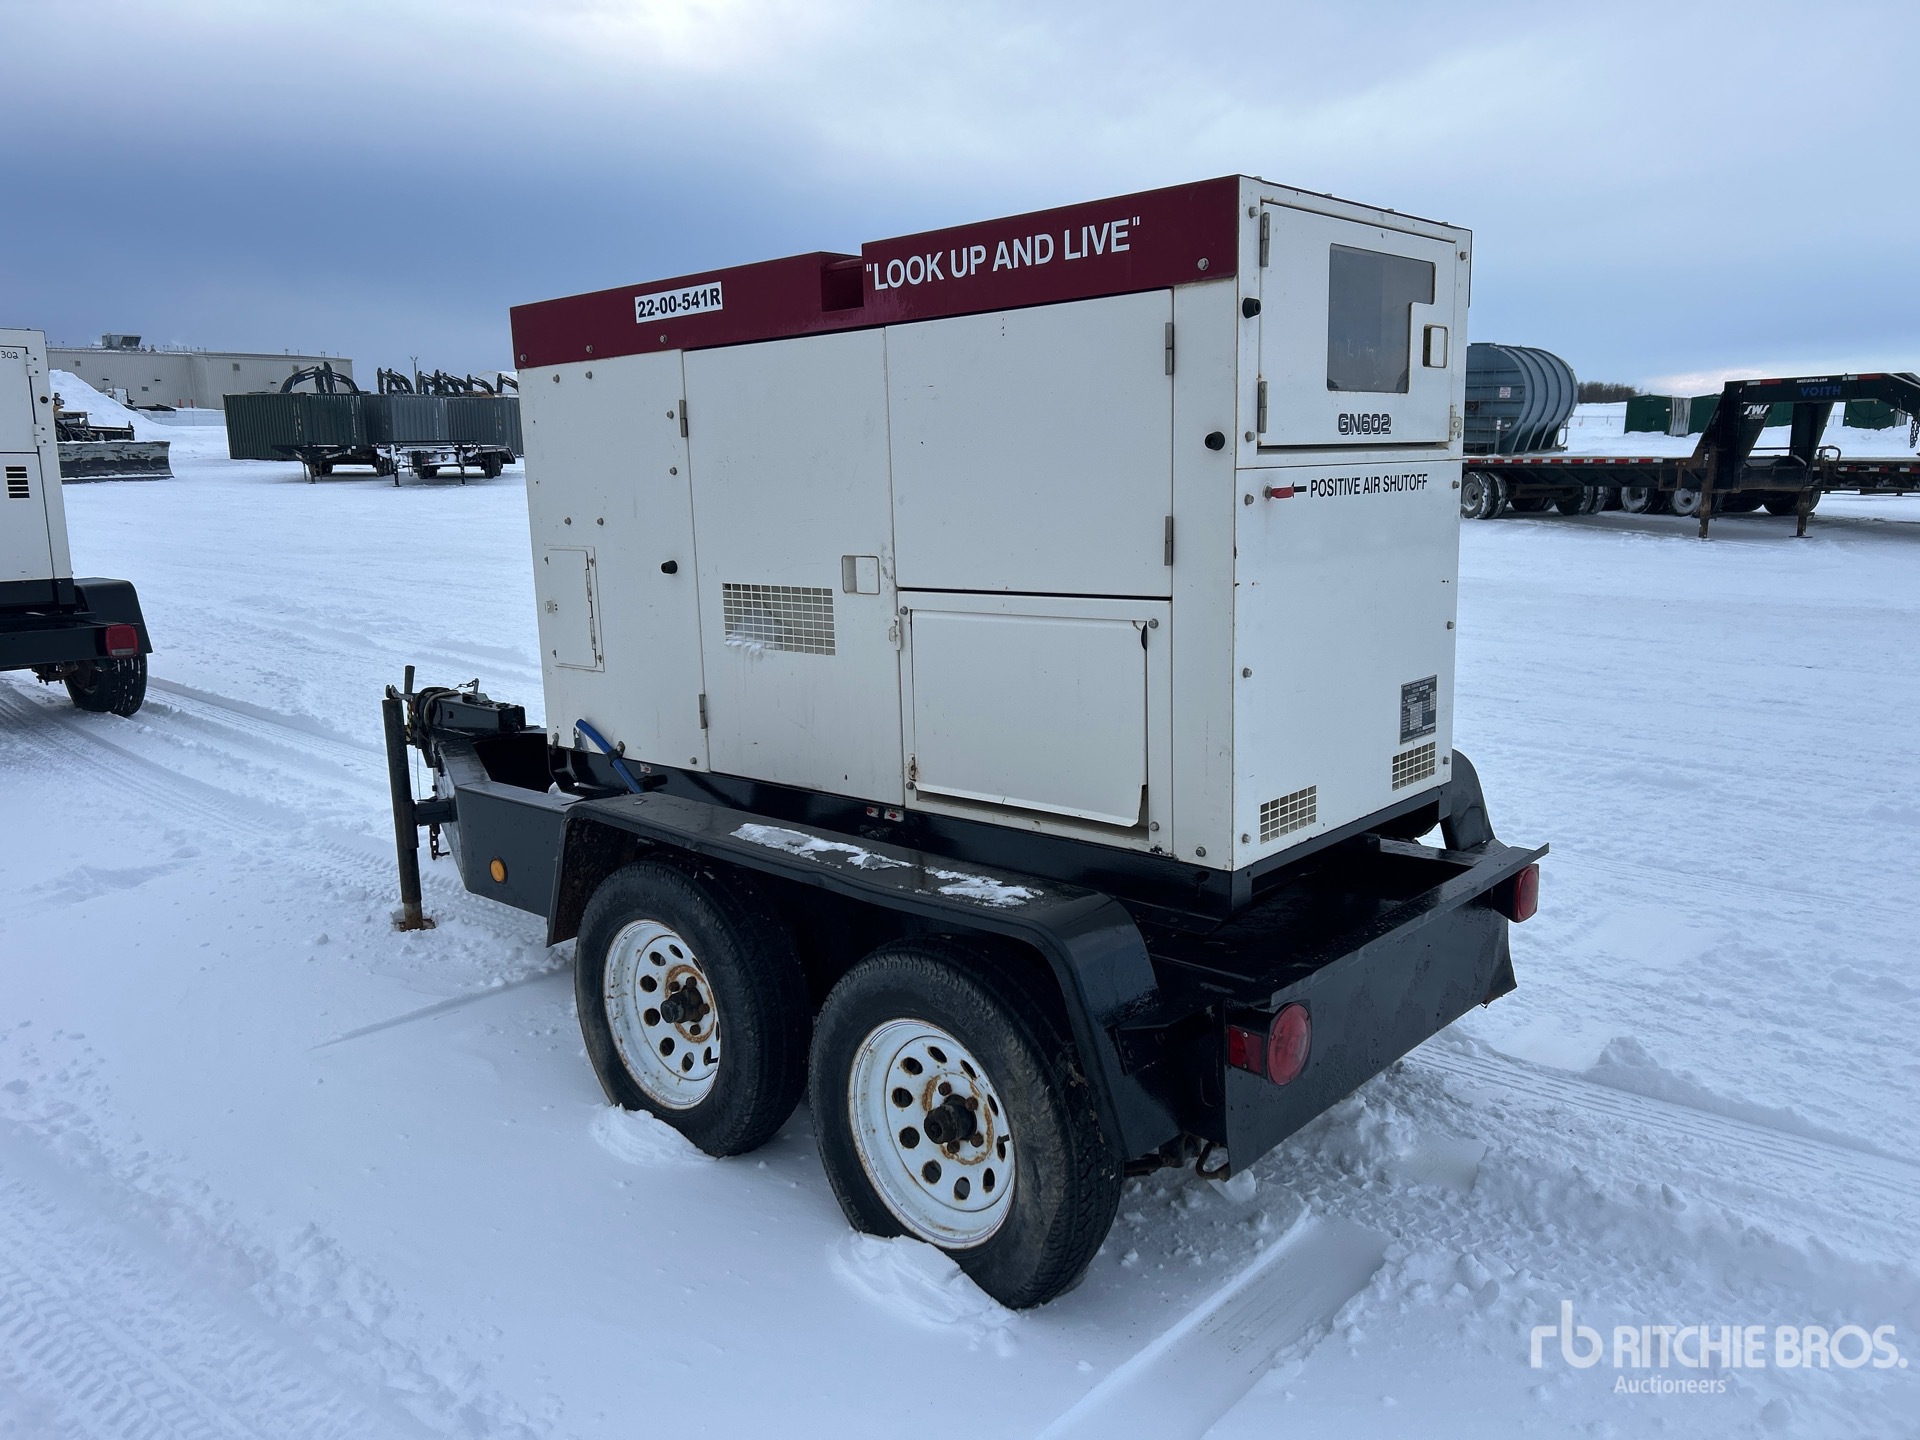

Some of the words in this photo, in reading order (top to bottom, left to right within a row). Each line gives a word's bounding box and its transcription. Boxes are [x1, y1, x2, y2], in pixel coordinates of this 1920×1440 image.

[866, 251, 945, 291] "LOOK
[950, 245, 987, 279] UP
[992, 233, 1055, 272] AND
[1064, 216, 1141, 260] LIVE"
[637, 287, 721, 319] 22-00-541R
[1800, 385, 1842, 397] VOITH
[1744, 404, 1770, 416] SWS
[1338, 413, 1392, 435] GN602
[1310, 477, 1361, 498] POSITIVE
[1363, 476, 1381, 494] AIR
[1383, 473, 1428, 493] SHUTOFF
